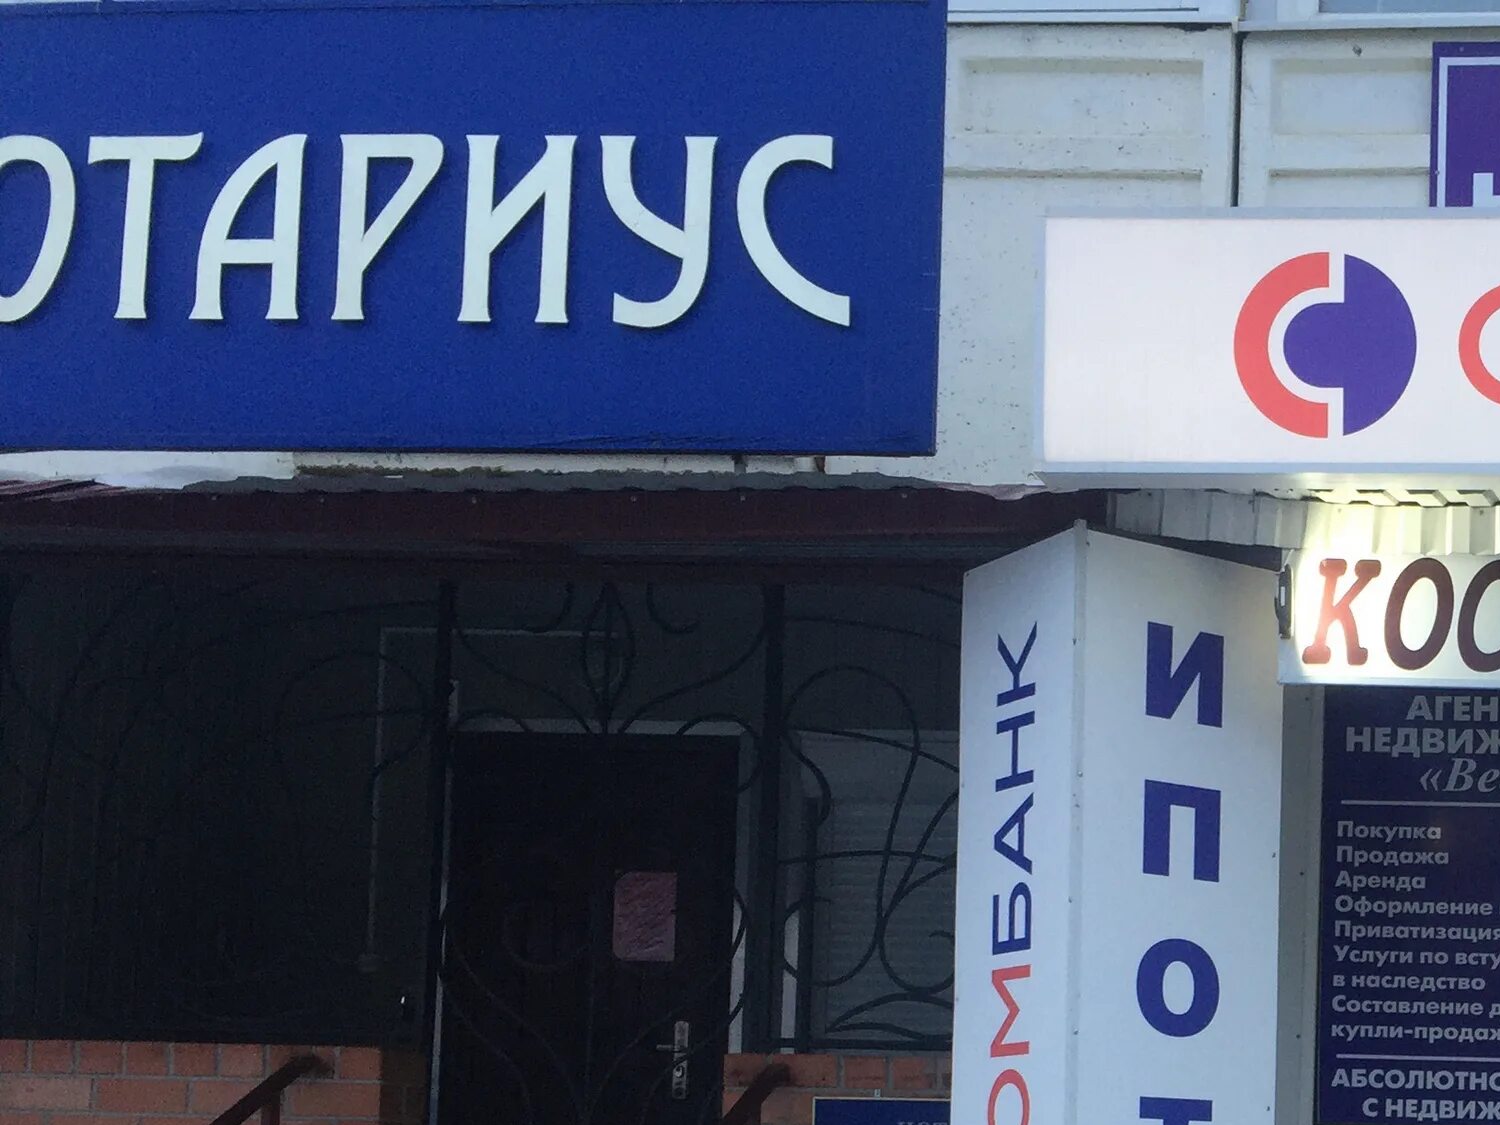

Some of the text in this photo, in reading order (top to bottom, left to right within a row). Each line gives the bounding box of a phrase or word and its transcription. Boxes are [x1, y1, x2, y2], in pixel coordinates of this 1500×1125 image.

[1336, 820, 1442, 844] Покупка
[1336, 844, 1449, 868] Продажа
[1335, 870, 1426, 892] Аренда
[1335, 895, 1493, 918] Оформление
[1333, 944, 1413, 968] Услуги
[1420, 951, 1449, 965] по
[1332, 974, 1486, 992] в наследство
[1331, 995, 1484, 1016] Составление
[1362, 1097, 1379, 1118] С
